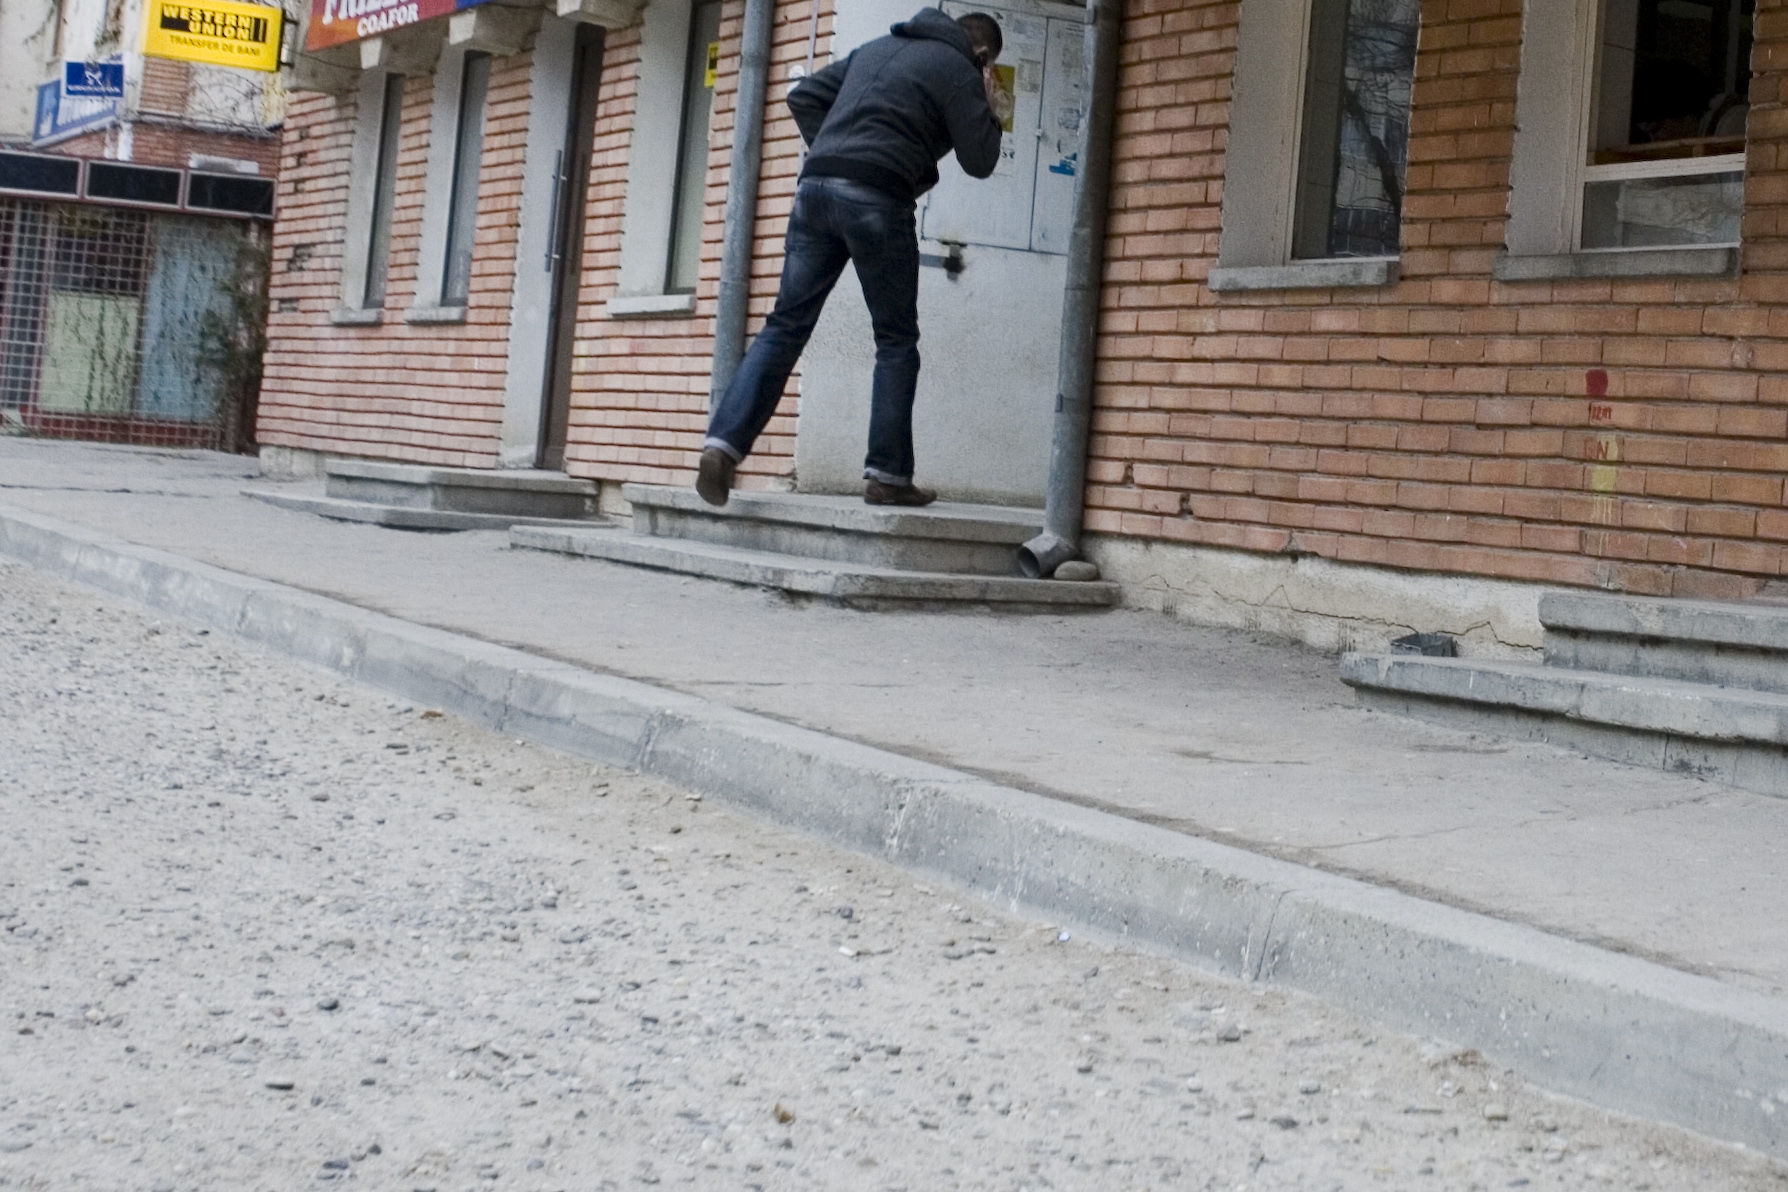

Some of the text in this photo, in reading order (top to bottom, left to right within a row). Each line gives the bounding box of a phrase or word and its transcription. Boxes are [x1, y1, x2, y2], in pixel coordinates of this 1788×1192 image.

[163, 4, 251, 28] WESTERN
[356, 3, 420, 37] COAFOR
[188, 19, 251, 41] UNION
[169, 35, 219, 50] TRANSFER
[222, 42, 234, 54] DE
